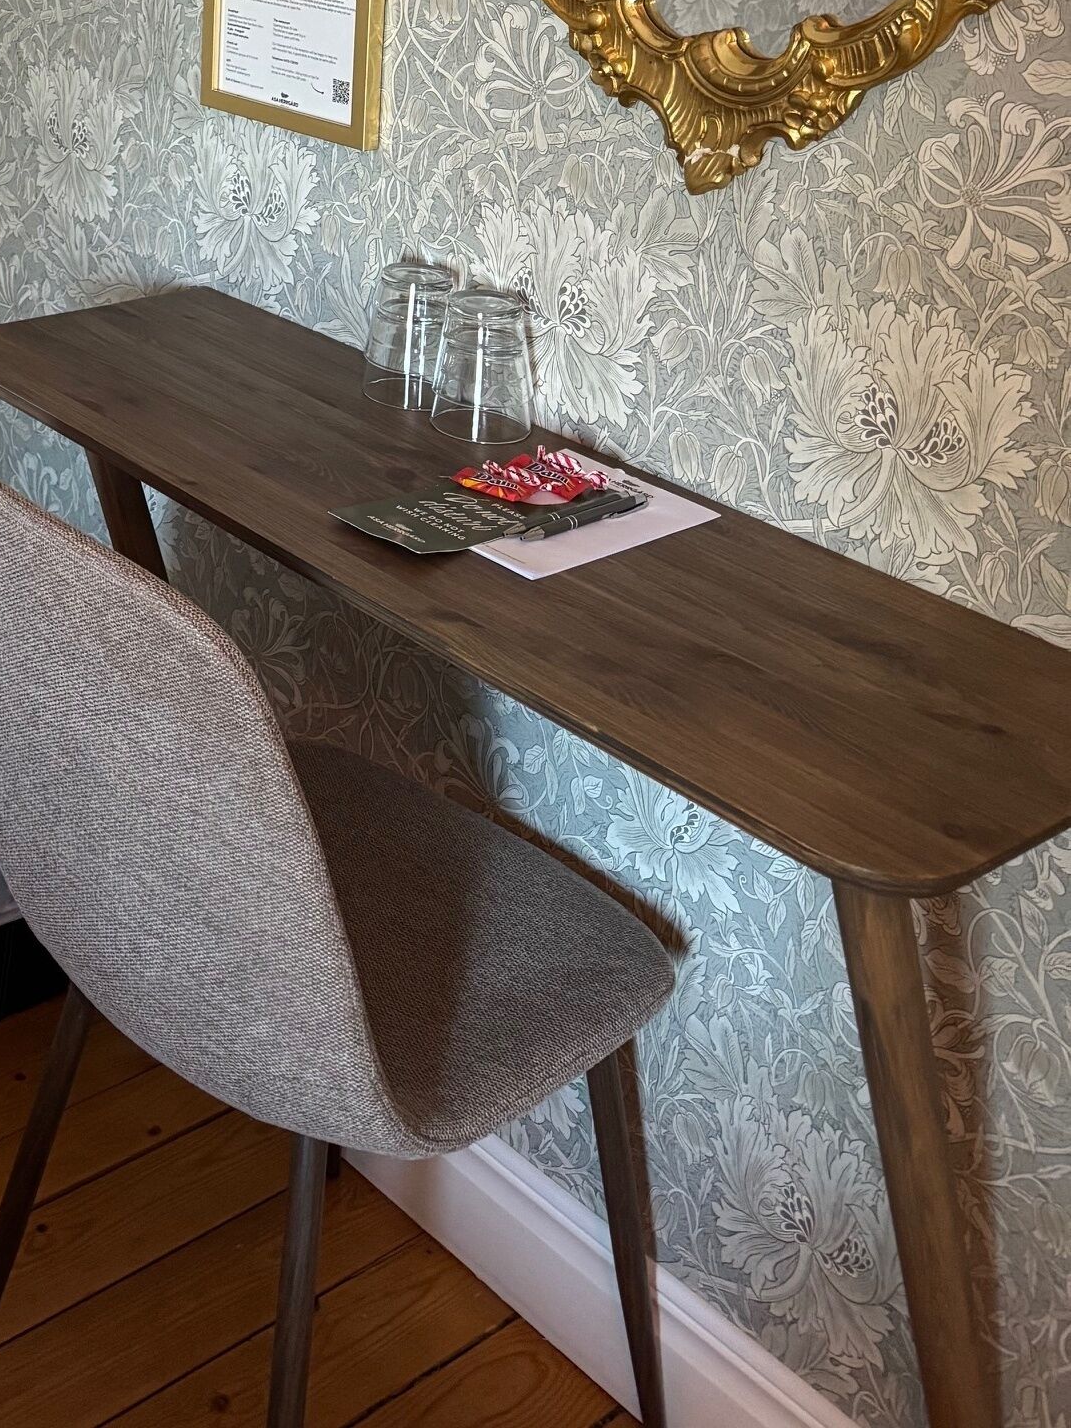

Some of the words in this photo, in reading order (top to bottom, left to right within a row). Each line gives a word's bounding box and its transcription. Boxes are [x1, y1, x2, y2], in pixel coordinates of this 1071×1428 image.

[474, 471, 518, 490] Daim
[528, 461, 570, 484] Daim
[413, 507, 428, 516] WE
[428, 515, 443, 524] DO
[443, 522, 466, 533] NOT
[491, 502, 527, 520] PLEASE
[395, 505, 420, 518] WISH
[419, 517, 466, 541] CLEANING
